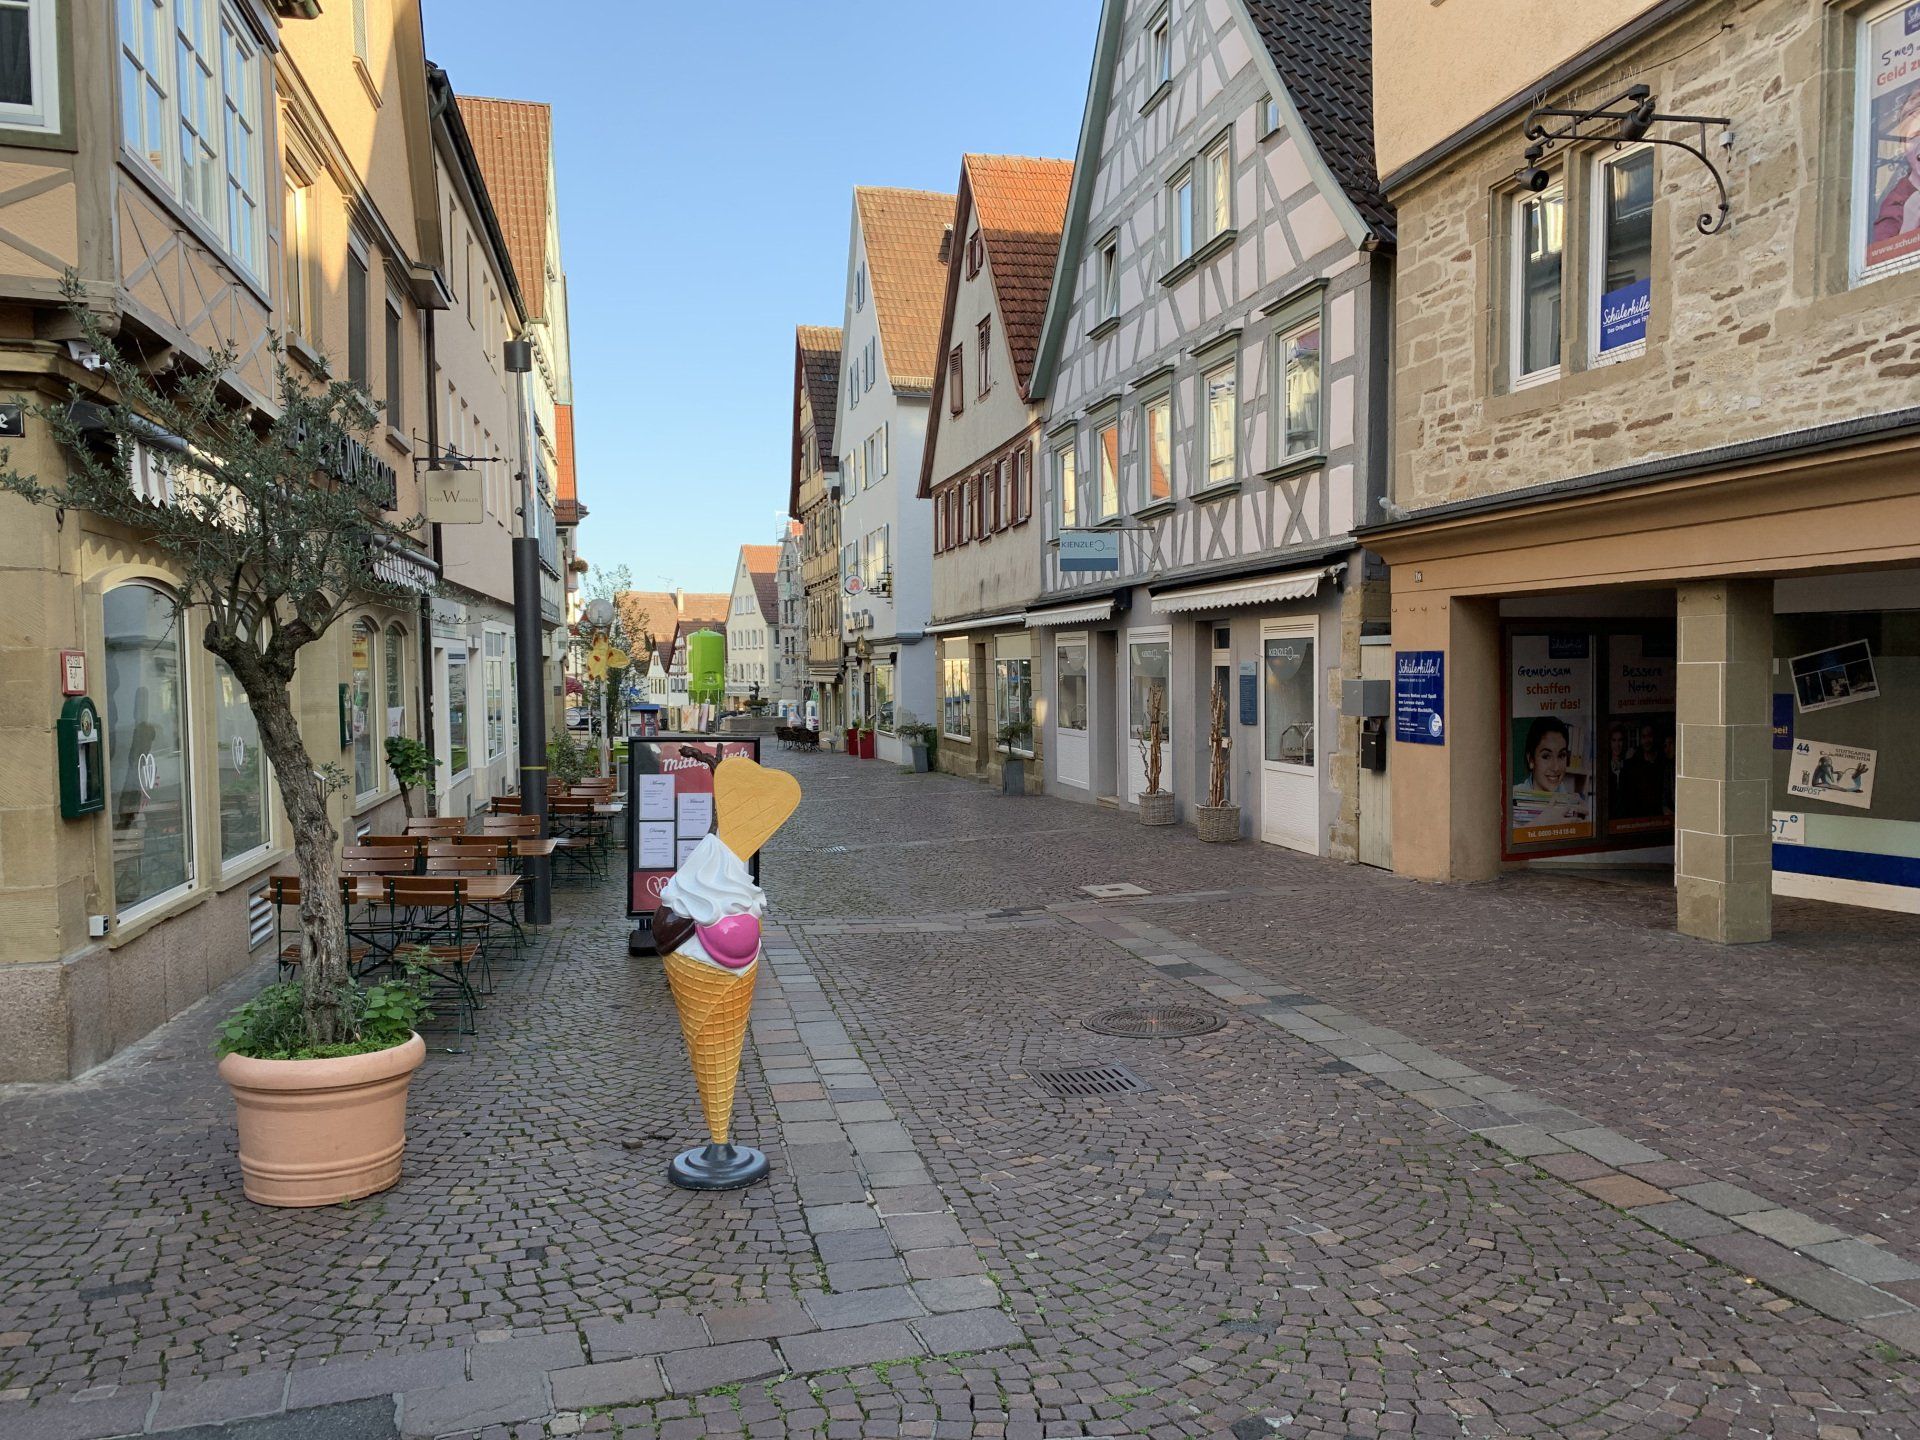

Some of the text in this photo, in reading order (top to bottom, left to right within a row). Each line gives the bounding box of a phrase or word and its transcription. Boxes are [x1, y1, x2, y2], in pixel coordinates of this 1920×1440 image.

[1876, 62, 1907, 86] Geld
[1061, 541, 1095, 549] KIENZLE
[1398, 658, 1441, 679] Schülerhilfe!
[1517, 666, 1571, 678] Gemeinsam
[1622, 664, 1663, 677] Bessere
[1526, 683, 1571, 695] schaffen
[1540, 699, 1581, 711] wir das!
[1796, 743, 1810, 753] 44
